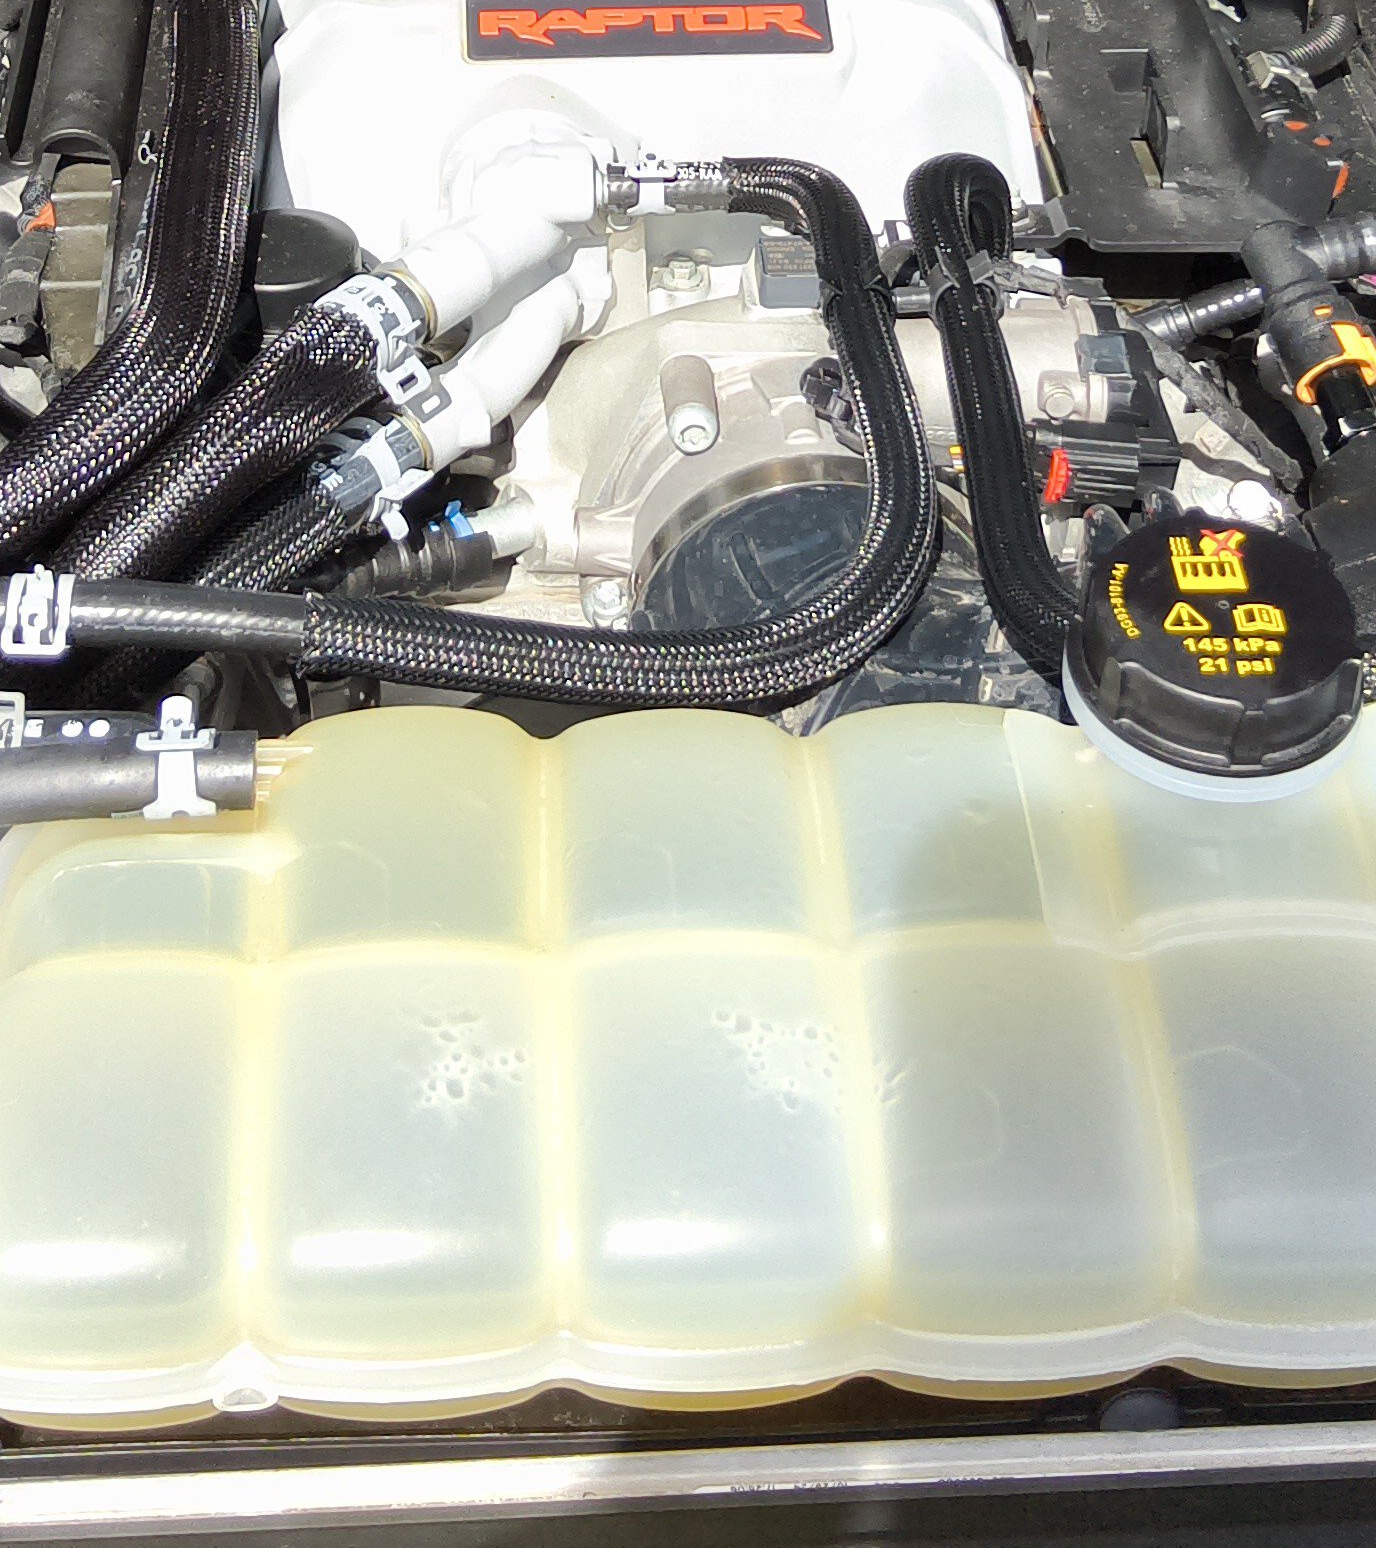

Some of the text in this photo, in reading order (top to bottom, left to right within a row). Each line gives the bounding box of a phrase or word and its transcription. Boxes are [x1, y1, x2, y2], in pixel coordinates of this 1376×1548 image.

[478, 4, 822, 46] RAPTOR
[1182, 636, 1282, 655] 145 kPa
[1197, 656, 1275, 676] 21 psi
